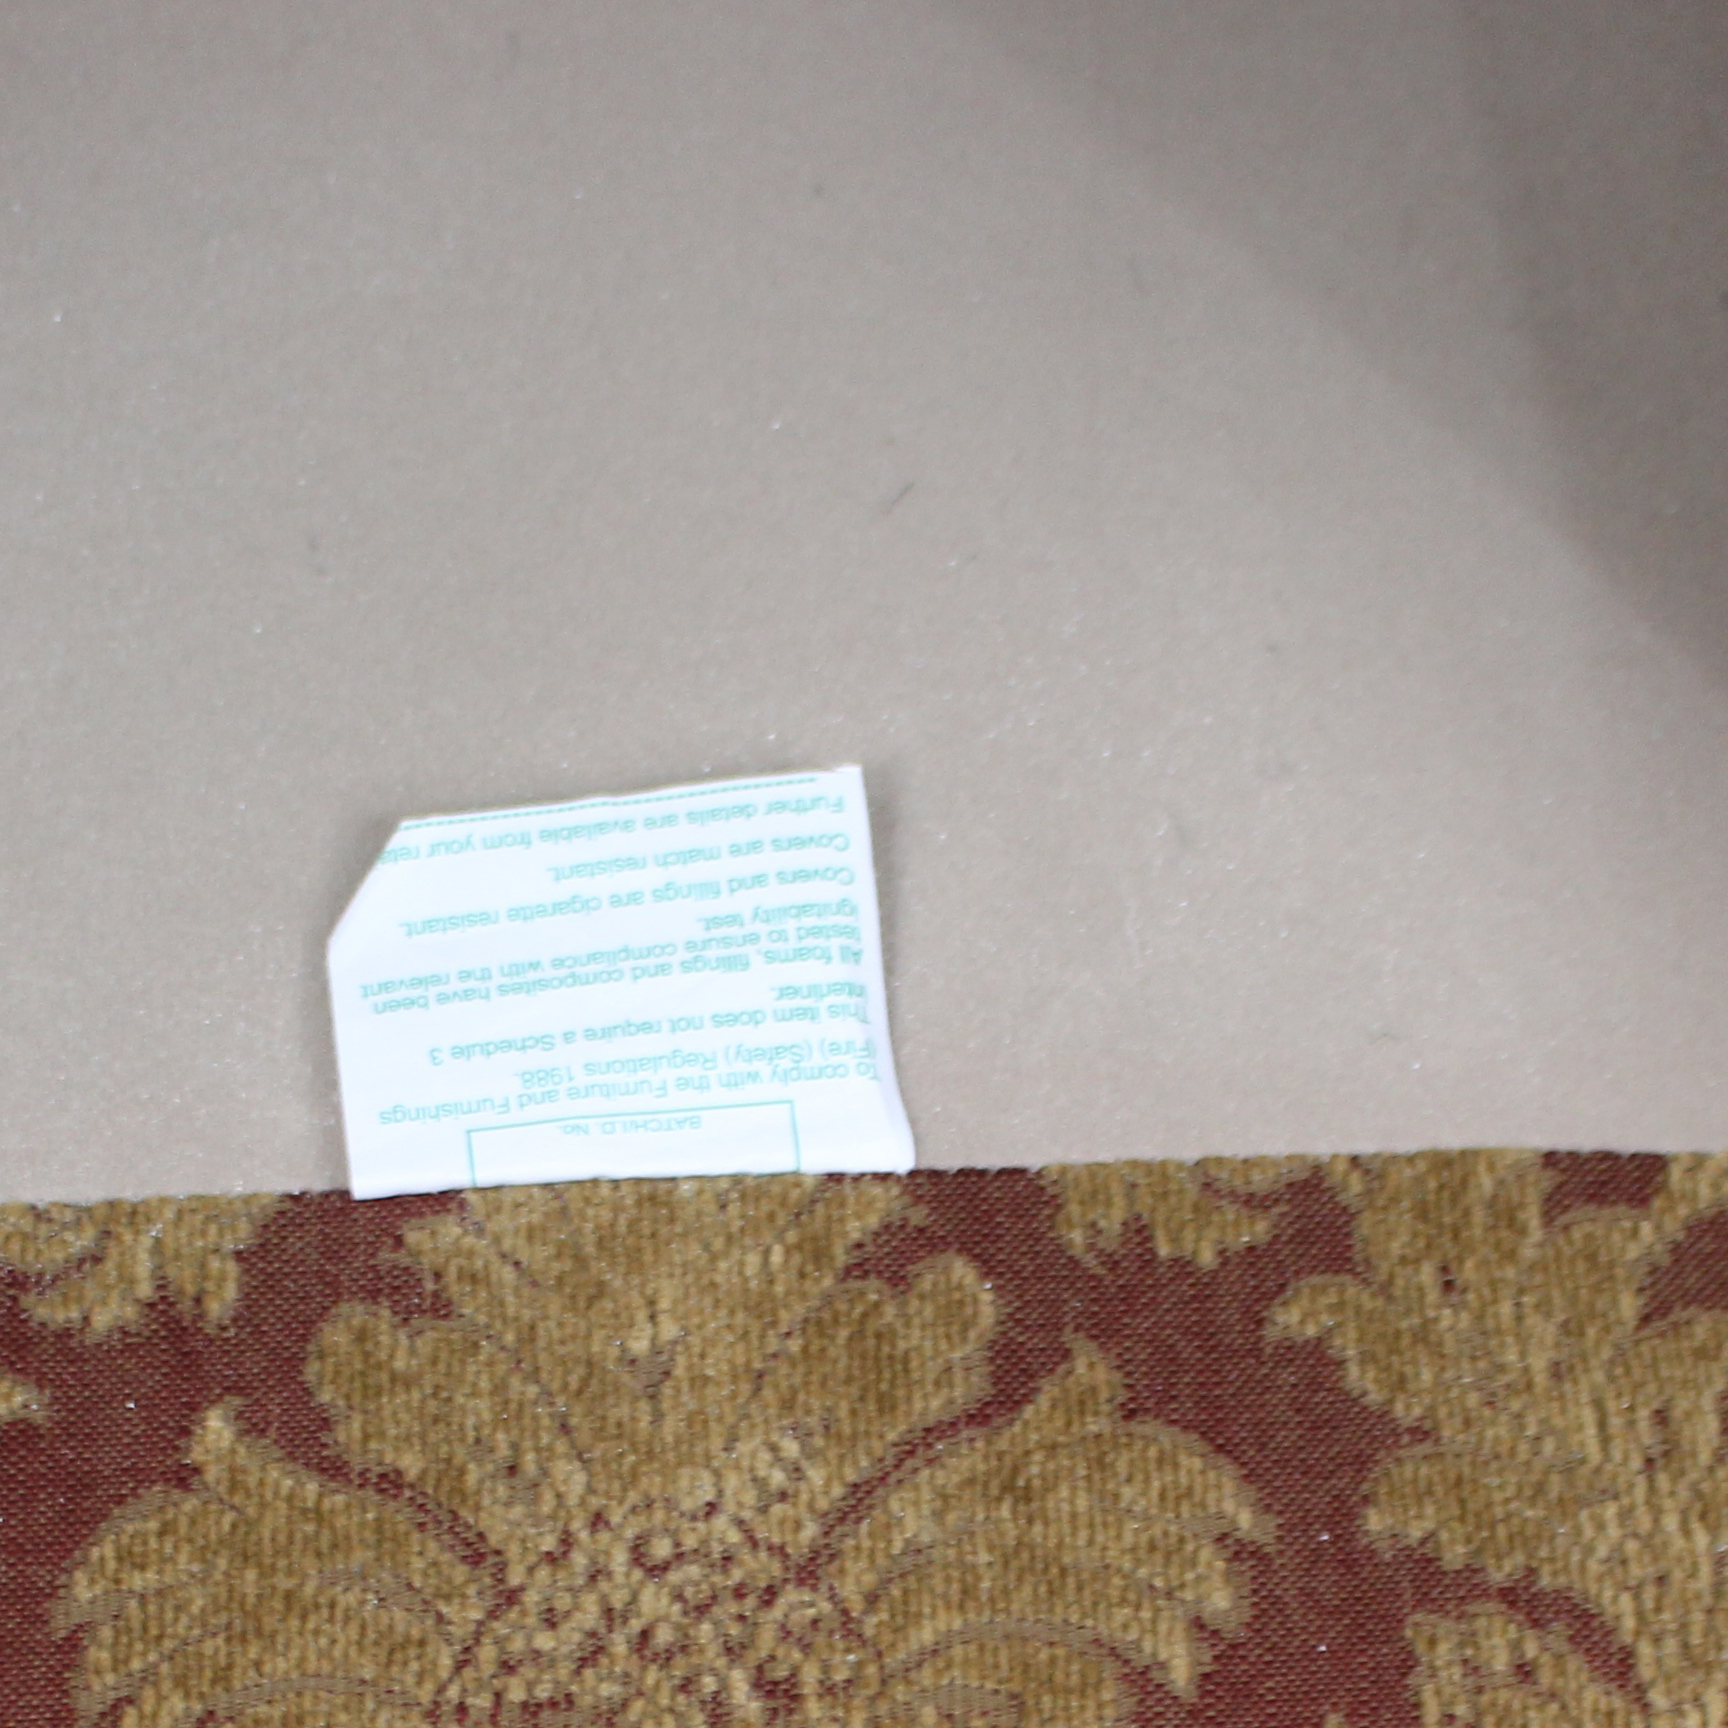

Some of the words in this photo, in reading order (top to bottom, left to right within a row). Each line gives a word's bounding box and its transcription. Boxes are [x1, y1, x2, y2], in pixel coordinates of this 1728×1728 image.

[686, 802, 758, 827] details
[764, 796, 845, 817] Further
[643, 813, 679, 831] are
[482, 831, 532, 851] from
[538, 820, 636, 846] available
[771, 833, 851, 852] Covers
[426, 833, 474, 858] your
[728, 838, 765, 858] are
[654, 846, 722, 870] match
[546, 855, 647, 883] resistant.
[776, 867, 855, 885] Covers
[652, 881, 722, 904] fillings
[729, 873, 769, 896] and
[507, 895, 603, 923] cigarette
[609, 890, 645, 908] are
[752, 898, 859, 924] ignitability
[399, 911, 500, 939] resistant.
[698, 913, 745, 932] test.
[685, 932, 761, 952] ensure
[767, 930, 789, 945] to
[797, 924, 861, 943] tested
[551, 943, 677, 971] compliance
[680, 955, 750, 975] fillings
[756, 946, 832, 966] foams,
[839, 946, 863, 966] All
[458, 967, 493, 984] the
[500, 960, 543, 980] with
[631, 963, 673, 981] and
[360, 973, 451, 1000] relevant
[497, 968, 624, 997] composites
[372, 995, 429, 1016] been
[436, 986, 491, 1006] have
[711, 1011, 766, 1029] does
[773, 1007, 820, 1024] item
[828, 1004, 869, 1024] This
[583, 1020, 662, 1043] require
[670, 1016, 704, 1034] not
[451, 1034, 556, 1061] Schedule
[563, 1030, 576, 1045] a
[429, 1048, 444, 1067] 3
[725, 1040, 813, 1066] (Safety)
[820, 1038, 875, 1060] (Fire)
[583, 1050, 717, 1078] Regulations
[857, 1062, 879, 1081] To
[513, 1066, 576, 1089] 1988.
[676, 1076, 711, 1094] the
[719, 1071, 763, 1090] with
[770, 1064, 849, 1086] comply
[518, 1090, 560, 1111] and
[566, 1080, 668, 1101] Furniture
[379, 1096, 510, 1125] Furnishings
[557, 1123, 589, 1136] No.
